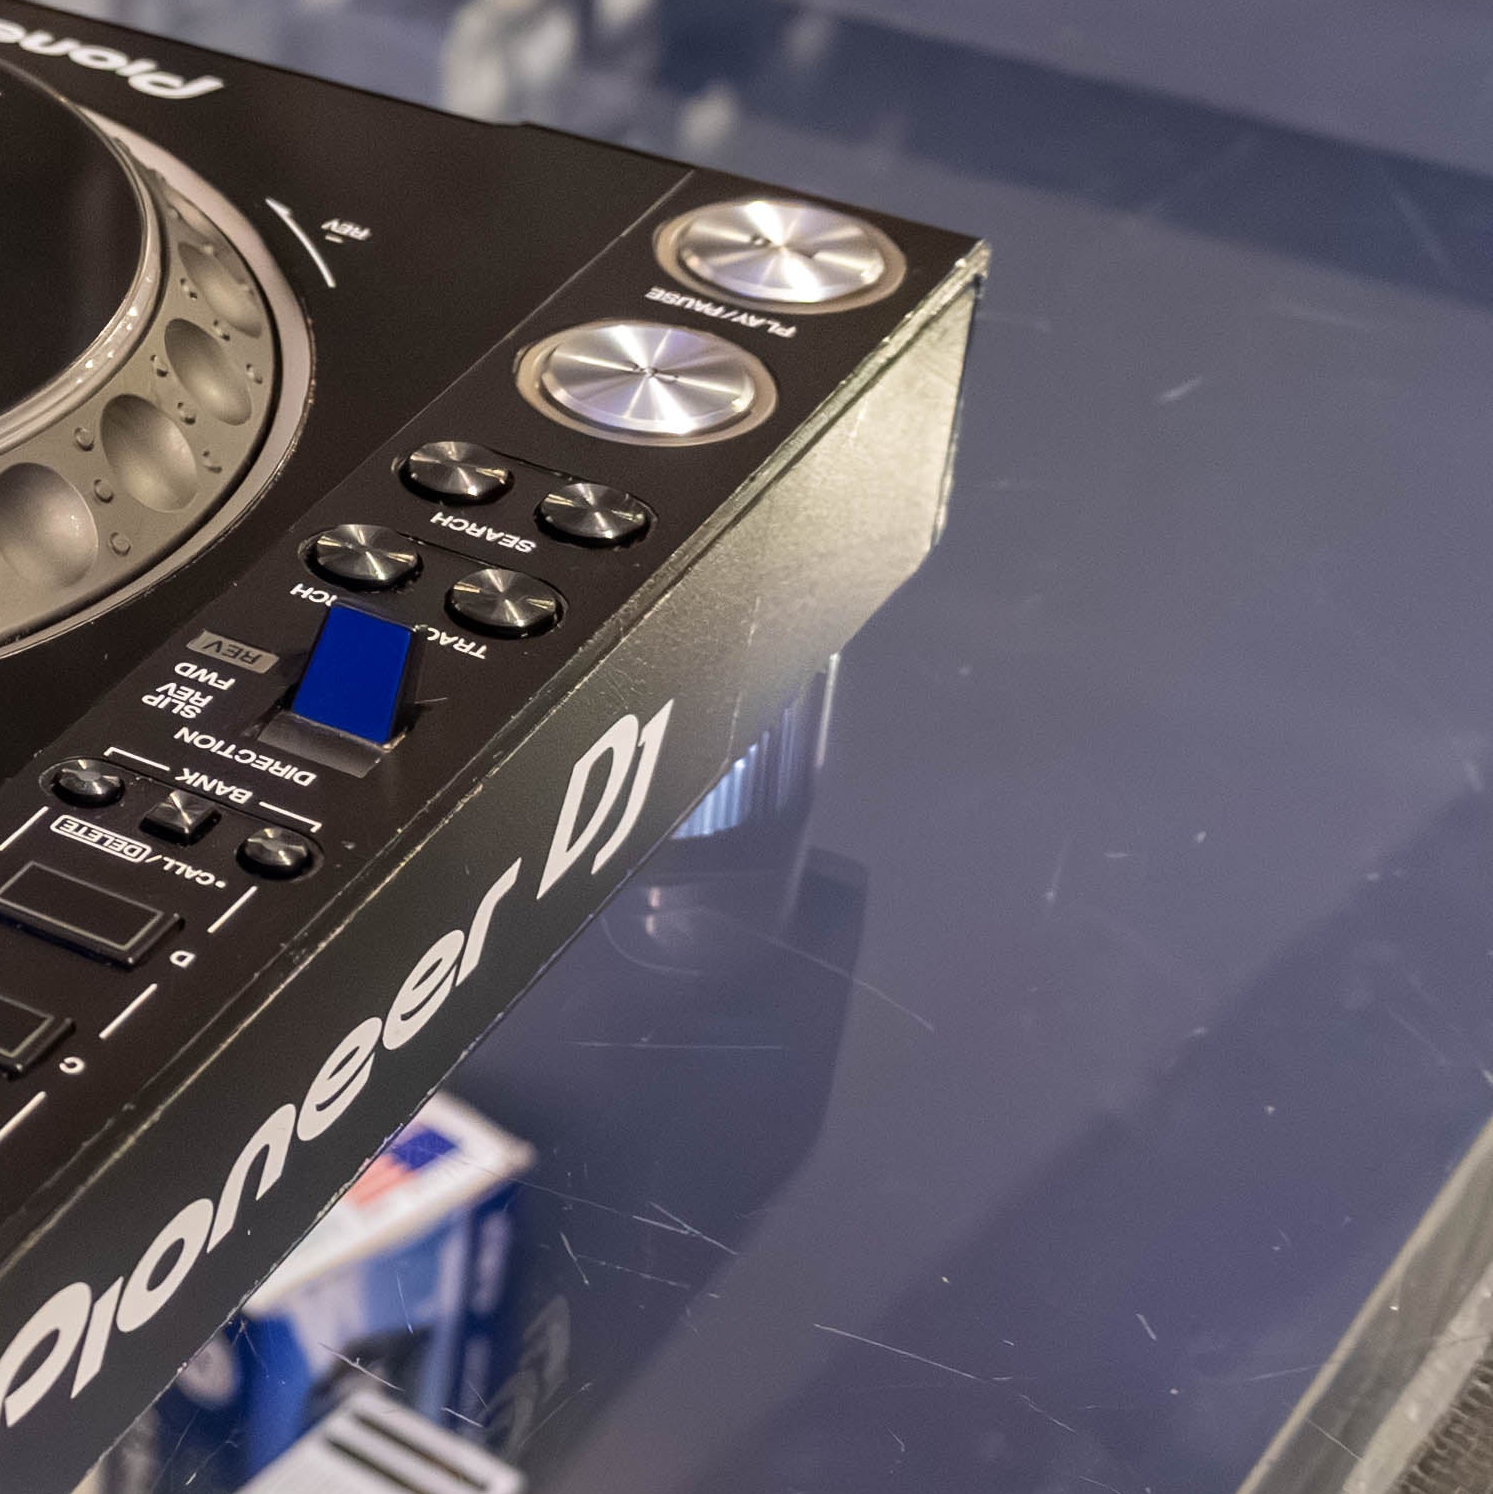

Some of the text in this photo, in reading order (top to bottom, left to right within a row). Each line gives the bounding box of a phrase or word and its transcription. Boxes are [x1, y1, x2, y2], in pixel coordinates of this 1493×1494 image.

[645, 285, 797, 338] PLAY/PAUSE
[430, 511, 537, 554] SEARCH
[203, 638, 263, 666] REV
[415, 622, 489, 660] TRAC
[173, 661, 237, 691] FWD
[141, 694, 203, 719] SLIP
[155, 682, 214, 708] REV
[173, 726, 317, 787] DIRECTION
[174, 767, 253, 805] BANK
[535, 699, 674, 900] DJ
[169, 949, 196, 968] D
[59, 1056, 86, 1076] C
